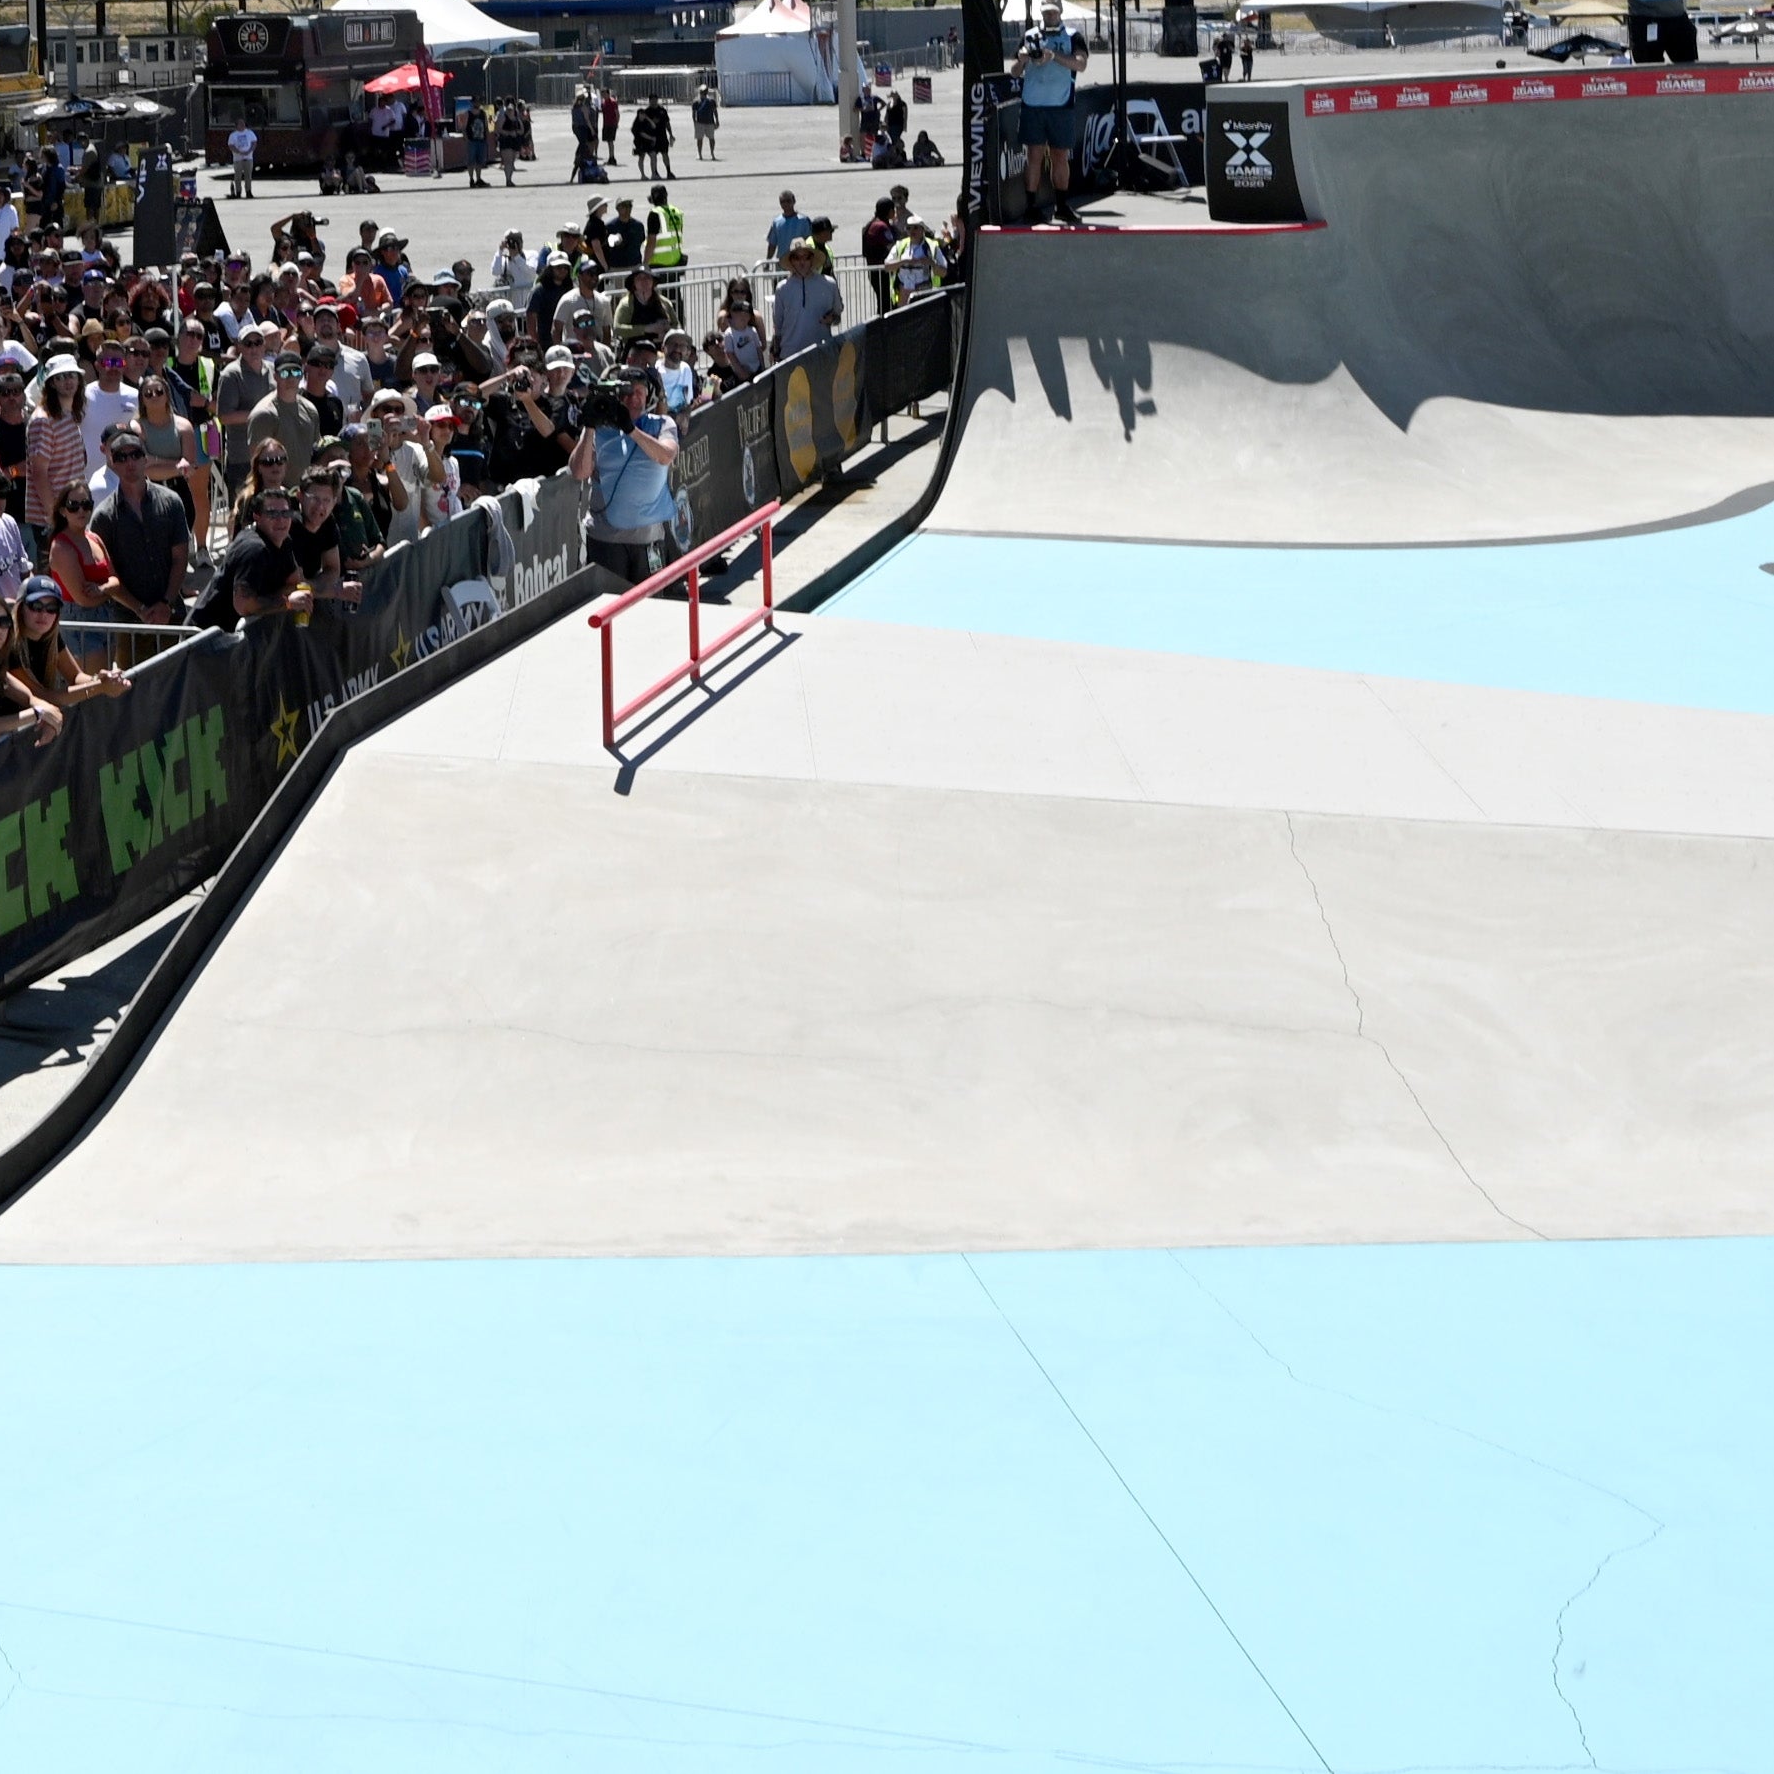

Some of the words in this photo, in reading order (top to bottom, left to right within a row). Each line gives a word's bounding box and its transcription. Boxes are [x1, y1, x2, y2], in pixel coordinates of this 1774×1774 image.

[968, 83, 986, 213] VIEWING
[1224, 167, 1273, 177] GAMES
[514, 543, 569, 608] Bobcat
[99, 703, 230, 875] KICK
